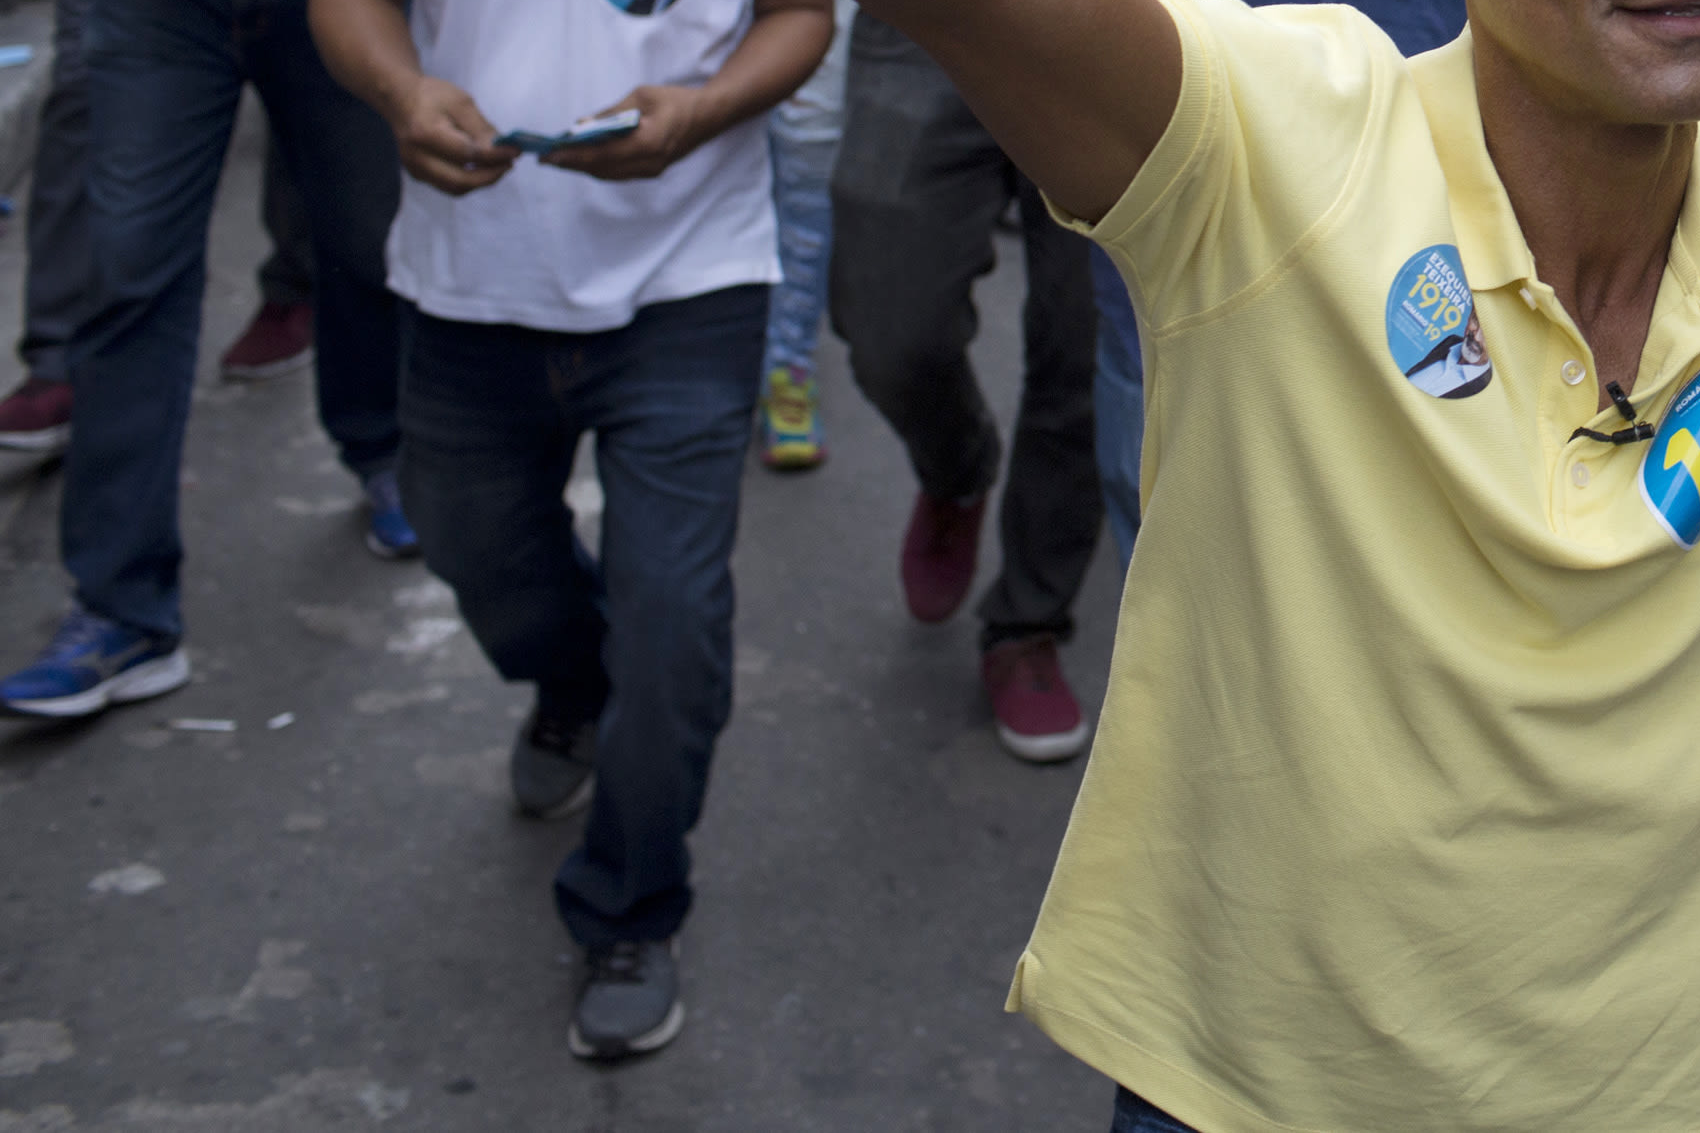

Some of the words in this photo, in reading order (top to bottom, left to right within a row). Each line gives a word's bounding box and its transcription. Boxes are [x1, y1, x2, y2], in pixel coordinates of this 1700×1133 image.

[1408, 274, 1462, 331] 1919
[1423, 262, 1466, 314] TEIXEIRA
[1428, 252, 1472, 306] EZEQUIEL
[1424, 323, 1441, 341] 19
